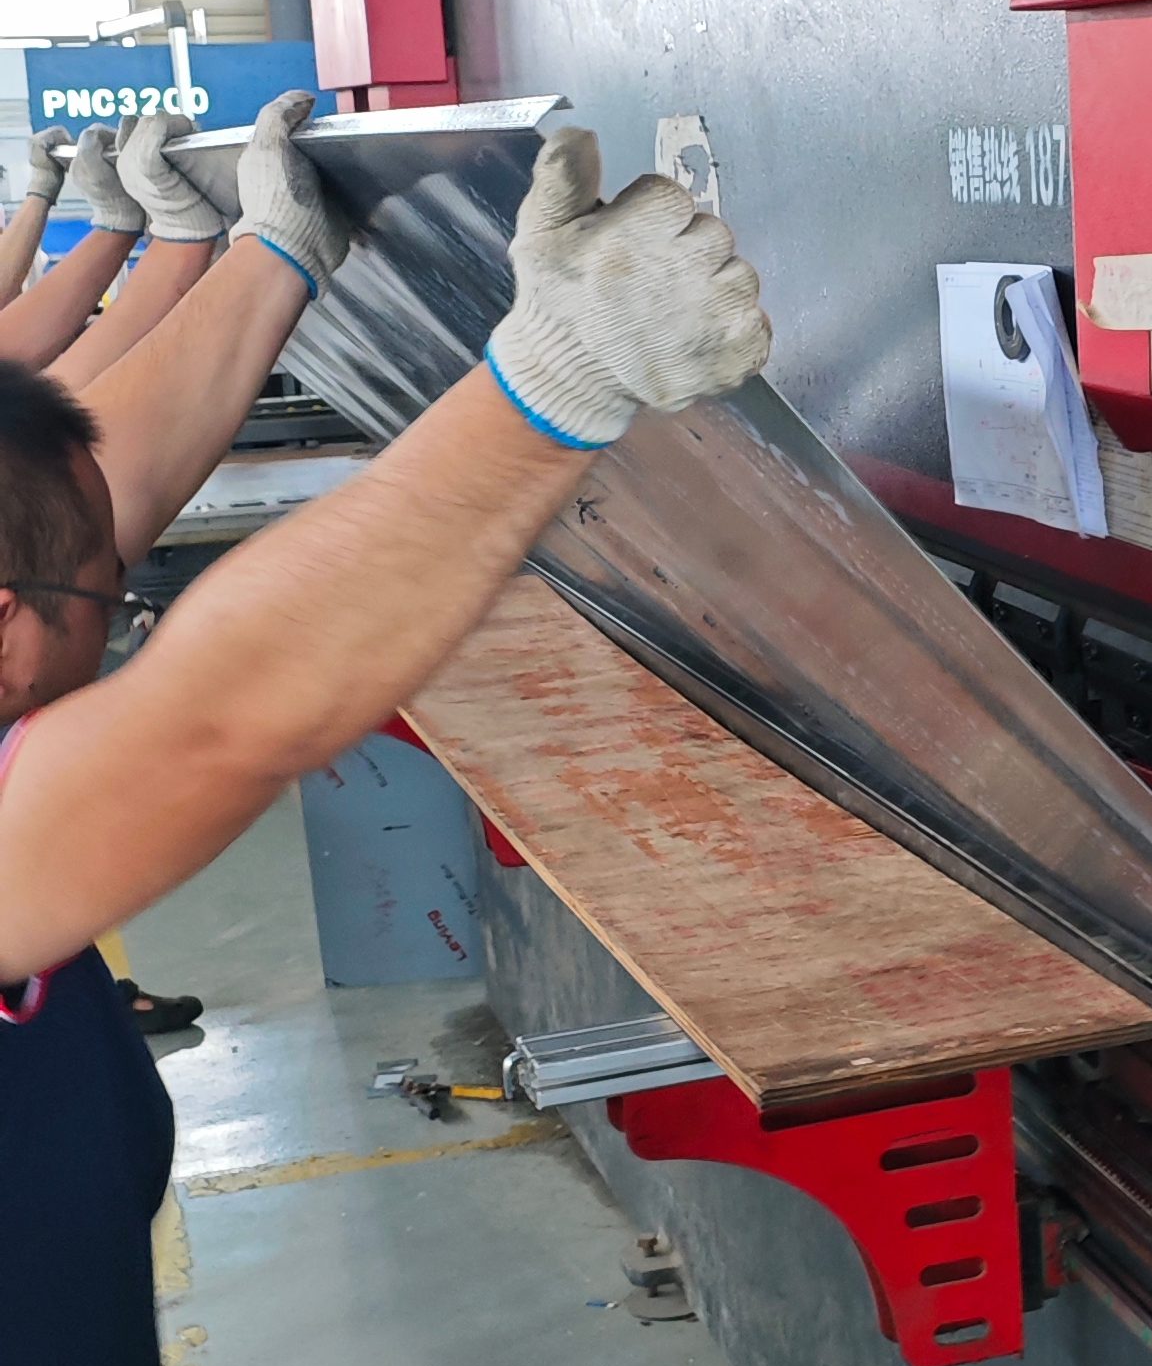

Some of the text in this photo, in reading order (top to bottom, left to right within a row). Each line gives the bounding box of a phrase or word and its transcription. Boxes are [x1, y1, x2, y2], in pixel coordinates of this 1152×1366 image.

[42, 86, 210, 118] PNC3200
[948, 124, 1066, 206] 销售热线 187
